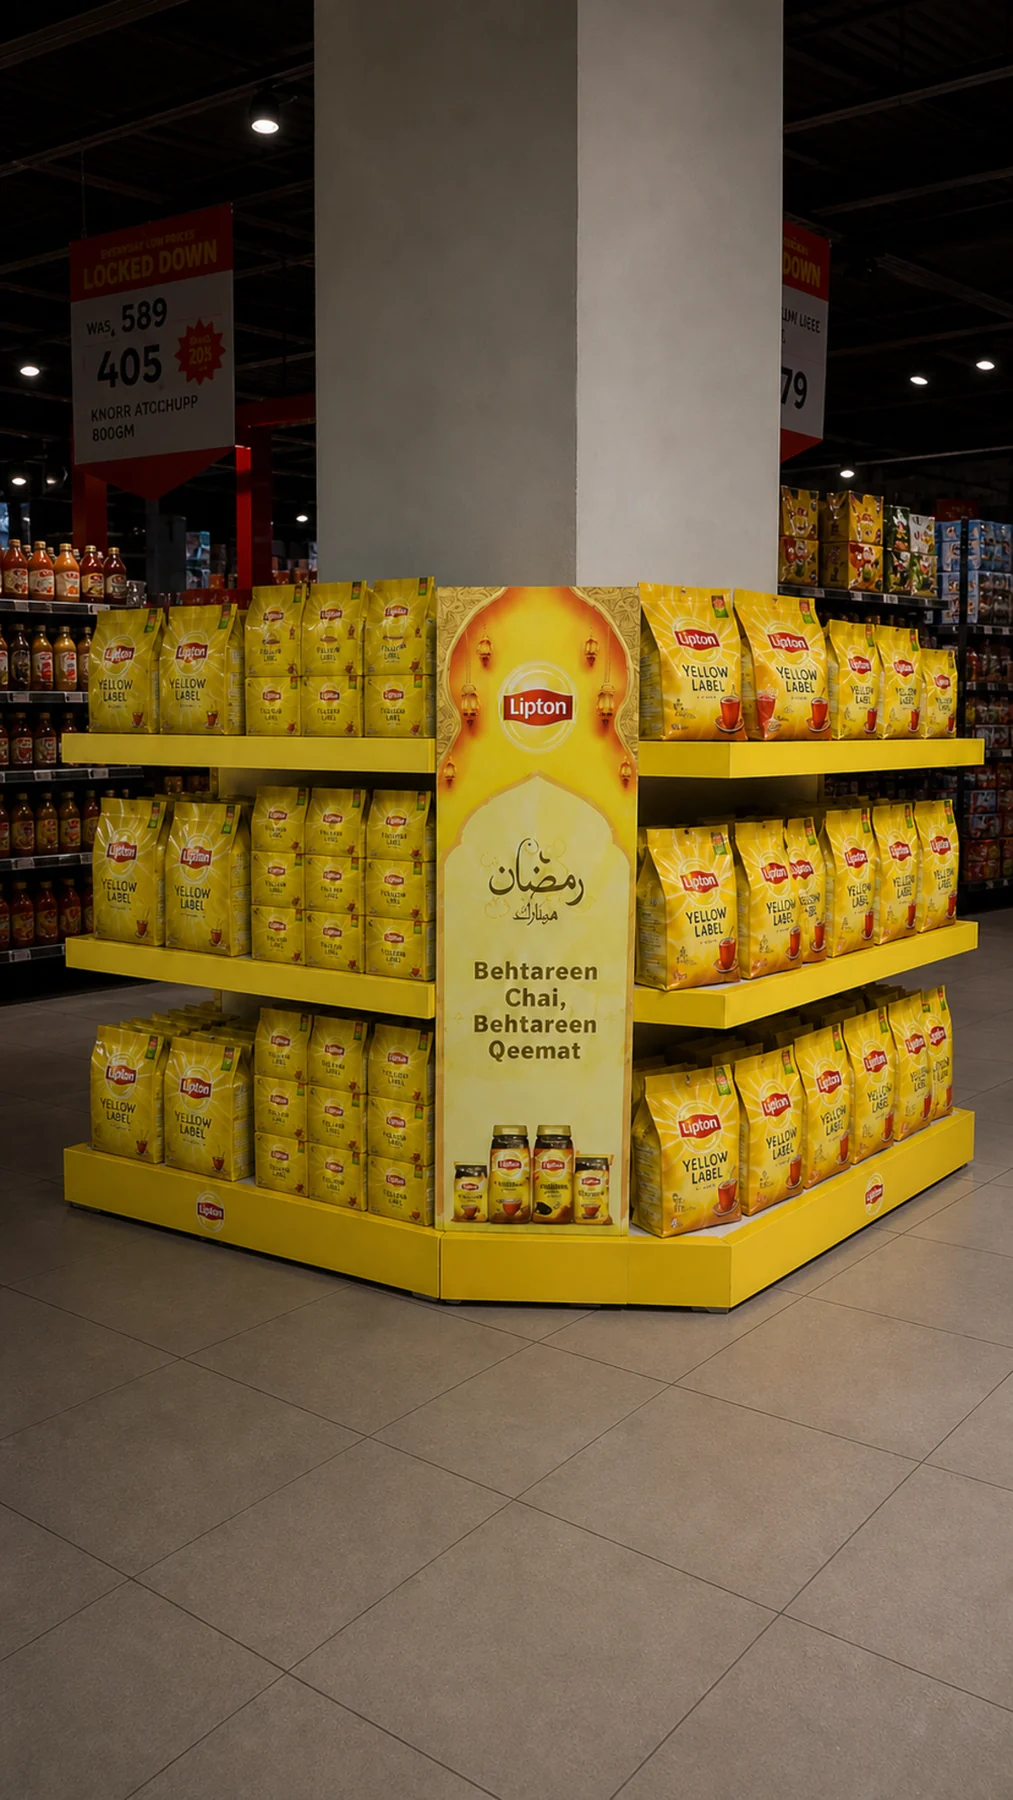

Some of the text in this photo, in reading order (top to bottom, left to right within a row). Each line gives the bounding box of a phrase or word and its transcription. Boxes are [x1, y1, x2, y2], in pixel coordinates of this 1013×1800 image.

[83, 238, 218, 290] LOCKED DOWN
[121, 297, 167, 332] 589
[97, 344, 162, 388] 405
[782, 366, 808, 410] 79
[91, 404, 131, 422] KNORR
[92, 423, 135, 442] 800GM
[679, 632, 716, 649] Lipton
[772, 635, 806, 650] Lipton
[682, 664, 728, 678] YELLOW
[776, 666, 818, 681] YELLOW
[98, 679, 134, 690] YELLOW
[169, 678, 207, 690] YELLOW
[692, 679, 726, 692] LABEL
[786, 681, 816, 694] LABEL
[175, 690, 201, 702] LABEL
[510, 698, 567, 719] Lipton
[489, 838, 584, 906] رمضان
[101, 878, 138, 893] YELLOW
[684, 874, 716, 891] Lipton
[107, 891, 132, 904] LABEL
[174, 885, 212, 900] YELLOW
[180, 898, 205, 912] LABEL
[766, 898, 797, 914] YELLOW
[686, 907, 728, 924] YELLOW
[694, 922, 724, 938] LABEL
[474, 961, 598, 980] Behtareen
[504, 988, 566, 1011] Chai,
[474, 1014, 597, 1034] Behtareen
[488, 1040, 582, 1062] Qeemat
[108, 1067, 136, 1084] Lipton
[182, 1079, 210, 1097] Lipton
[100, 1097, 137, 1114] YELLOW
[106, 1110, 132, 1125] LABEL
[174, 1110, 212, 1129] YELLOW
[180, 1124, 206, 1140] LABEL
[682, 1117, 719, 1136] Lipton
[766, 1127, 798, 1150] YELLOW
[682, 1150, 728, 1172] YELLOW
[691, 1168, 724, 1185] LABEL
